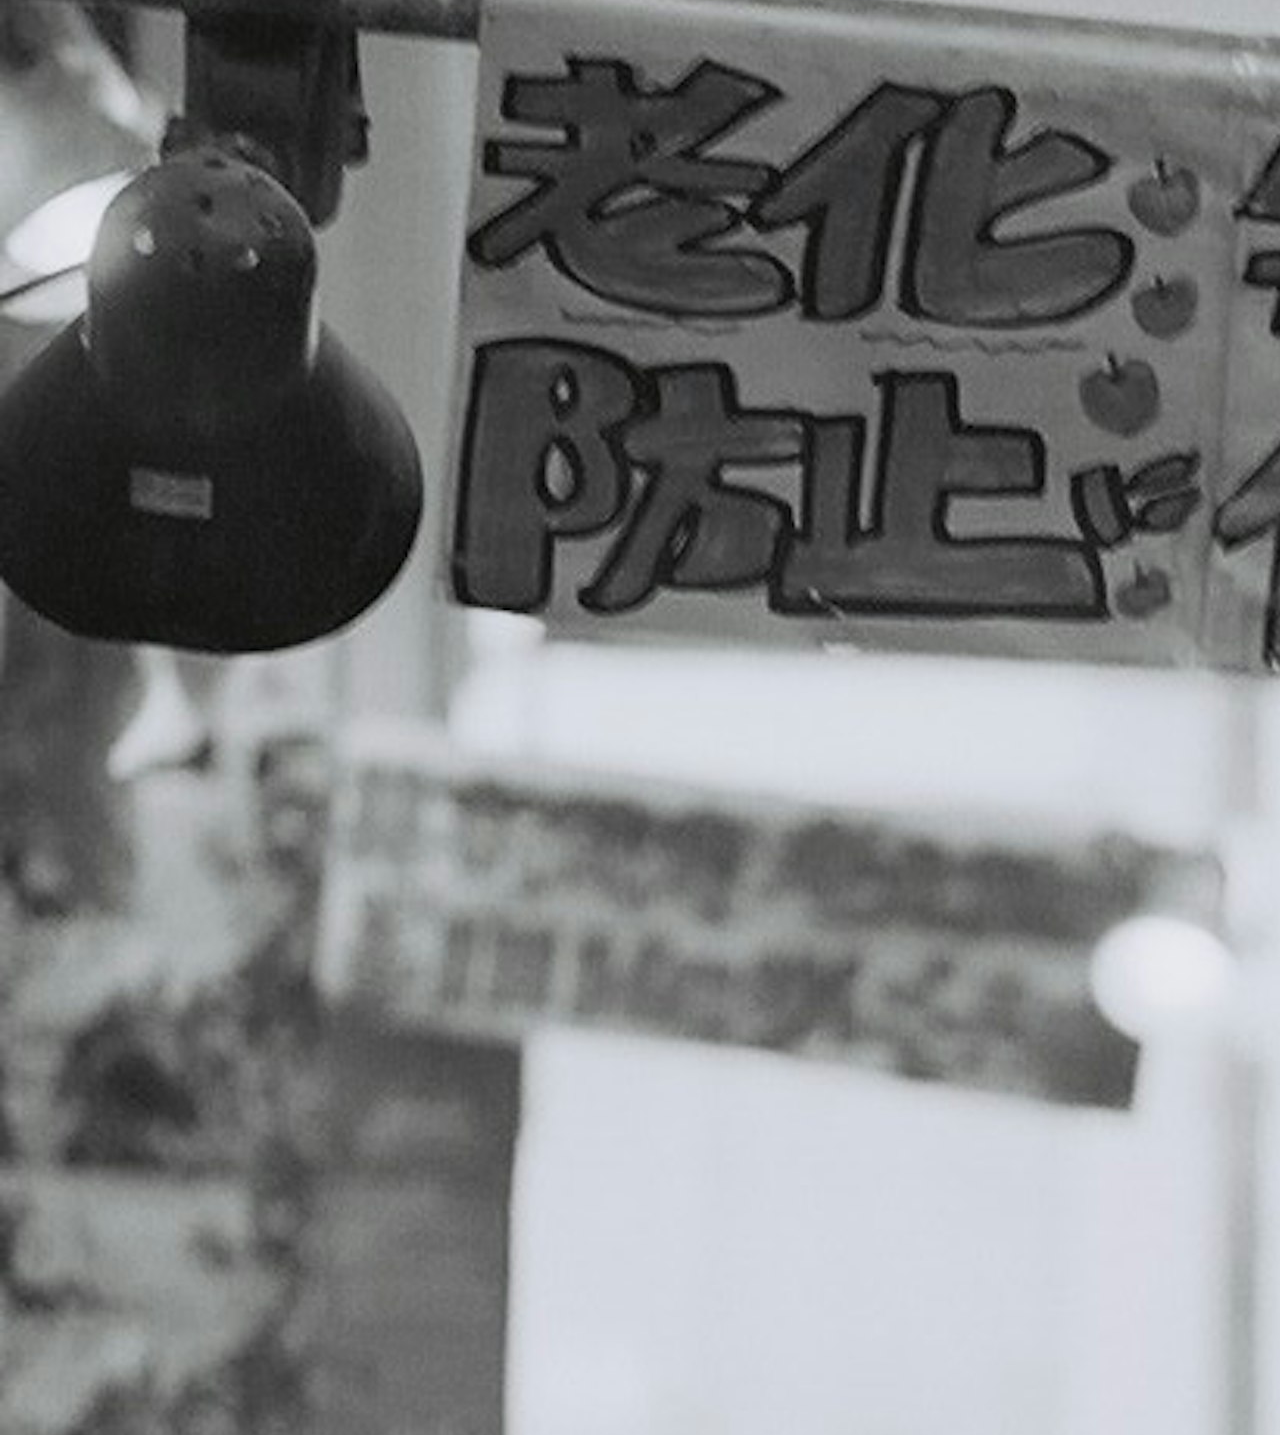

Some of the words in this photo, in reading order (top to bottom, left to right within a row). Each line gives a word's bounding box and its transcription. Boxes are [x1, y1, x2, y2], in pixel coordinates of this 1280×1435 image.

[466, 56, 1136, 328] 老化
[450, 336, 1202, 624] 防止に
